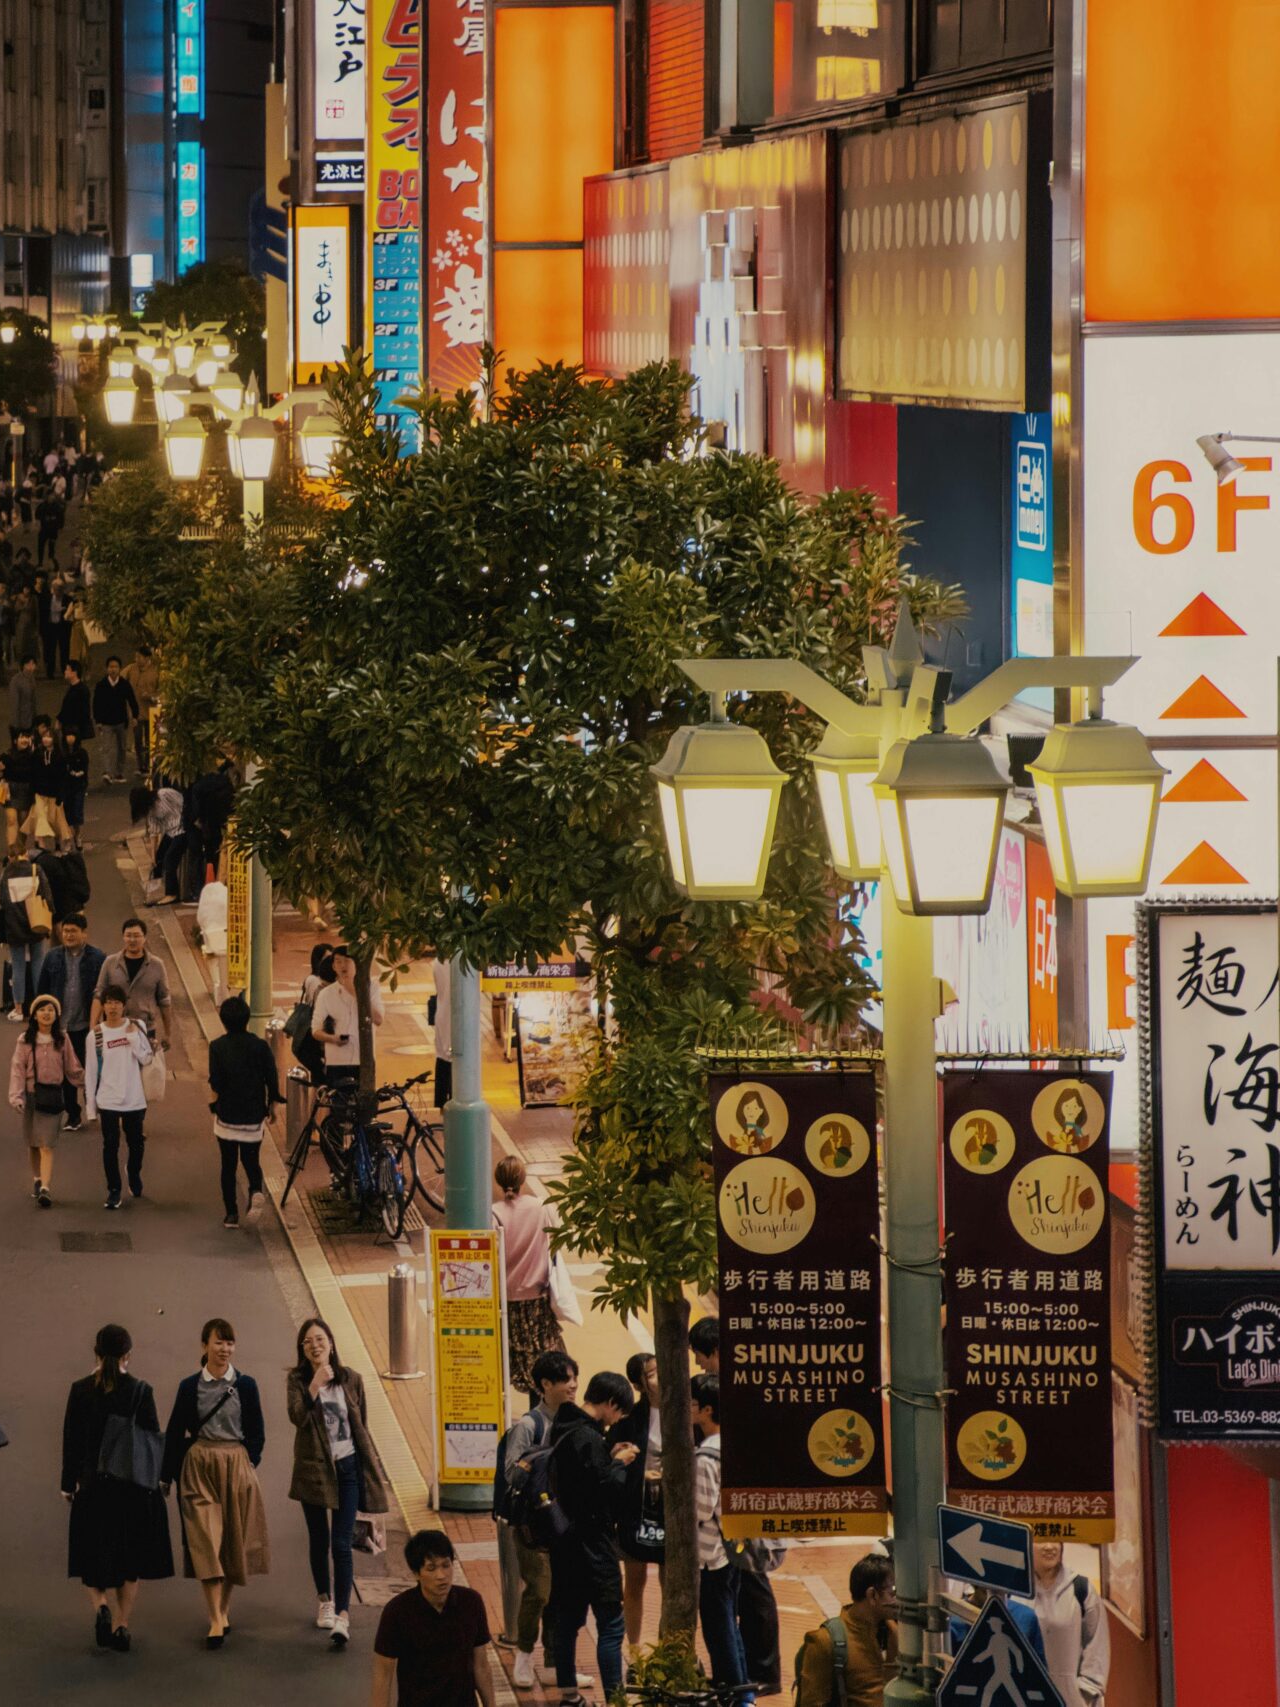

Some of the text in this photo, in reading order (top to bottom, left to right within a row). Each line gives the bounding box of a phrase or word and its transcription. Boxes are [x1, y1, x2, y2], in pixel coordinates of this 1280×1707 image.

[321, 163, 364, 181] 光涼ビ
[374, 233, 398, 245] 4F
[374, 279, 398, 291] 3F
[375, 324, 398, 336] 2F
[1132, 456, 1273, 556] 6F
[487, 964, 571, 977] 新宿武商栄会
[1175, 1145, 1200, 1245] らーめん
[724, 1269, 871, 1291] 歩行者用道路
[955, 1267, 1103, 1291] 歩行者用道路
[1231, 1301, 1280, 1321] SHINJUK
[1182, 1323, 1280, 1355] ハイボ
[734, 1343, 864, 1364] SHINJUKU
[967, 1343, 1097, 1367] SHINJUKU
[733, 1369, 865, 1385] MUSASHINO
[966, 1371, 1099, 1387] MUSASHINO
[764, 1388, 838, 1403] STREET
[997, 1390, 1070, 1405] STREET
[730, 1491, 878, 1512] 新宿武蔵野商栄会
[959, 1494, 1108, 1516] 新宿武蔵野商栄会
[639, 1524, 665, 1540] Lee
[761, 1517, 847, 1533] 路上喫煙禁止
